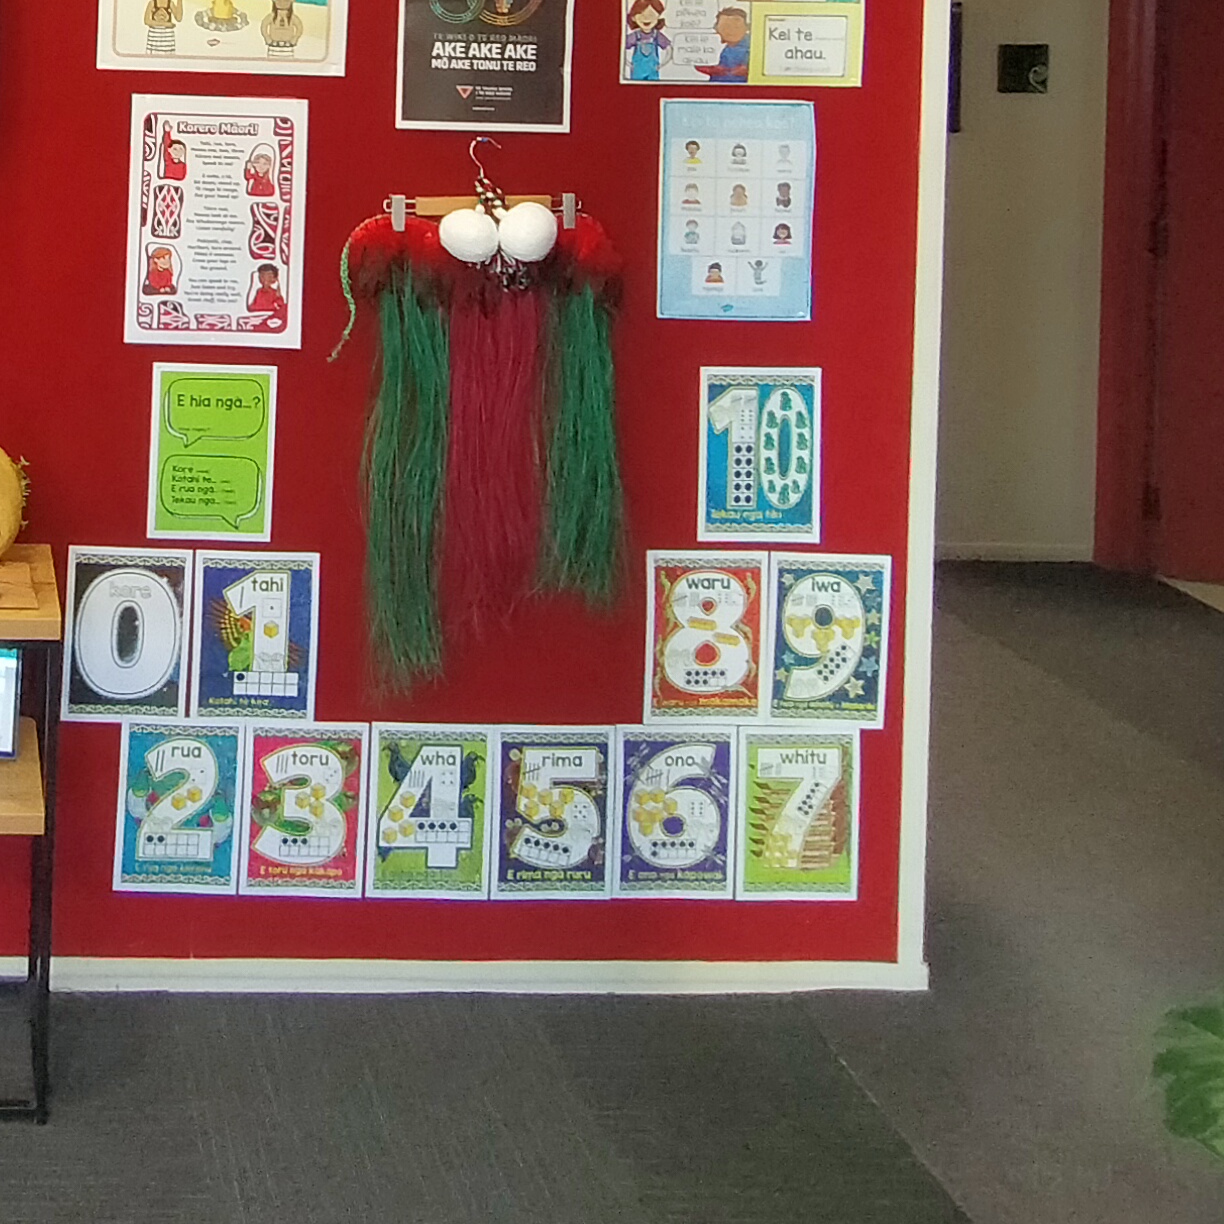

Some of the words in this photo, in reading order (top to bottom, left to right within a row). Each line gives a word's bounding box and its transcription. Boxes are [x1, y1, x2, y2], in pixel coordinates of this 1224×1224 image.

[768, 27, 791, 41] Kei
[795, 27, 813, 41] te
[431, 41, 466, 57] AKE
[468, 42, 502, 58] AKE
[504, 43, 538, 60] AKE
[784, 46, 826, 60] ahau.
[450, 59, 471, 70] AKE
[472, 59, 501, 71] TONU
[502, 60, 515, 71] TE
[516, 61, 537, 72] REO
[177, 394, 186, 407] E
[190, 394, 211, 407] hia
[107, 580, 152, 599] kore
[251, 577, 284, 593] tahi
[686, 577, 731, 591] waru
[811, 577, 841, 593] iwa
[171, 745, 202, 759] rua
[291, 750, 330, 766] toru
[779, 750, 827, 765] whitu
[541, 753, 584, 768] rima
[664, 755, 695, 767] ono
